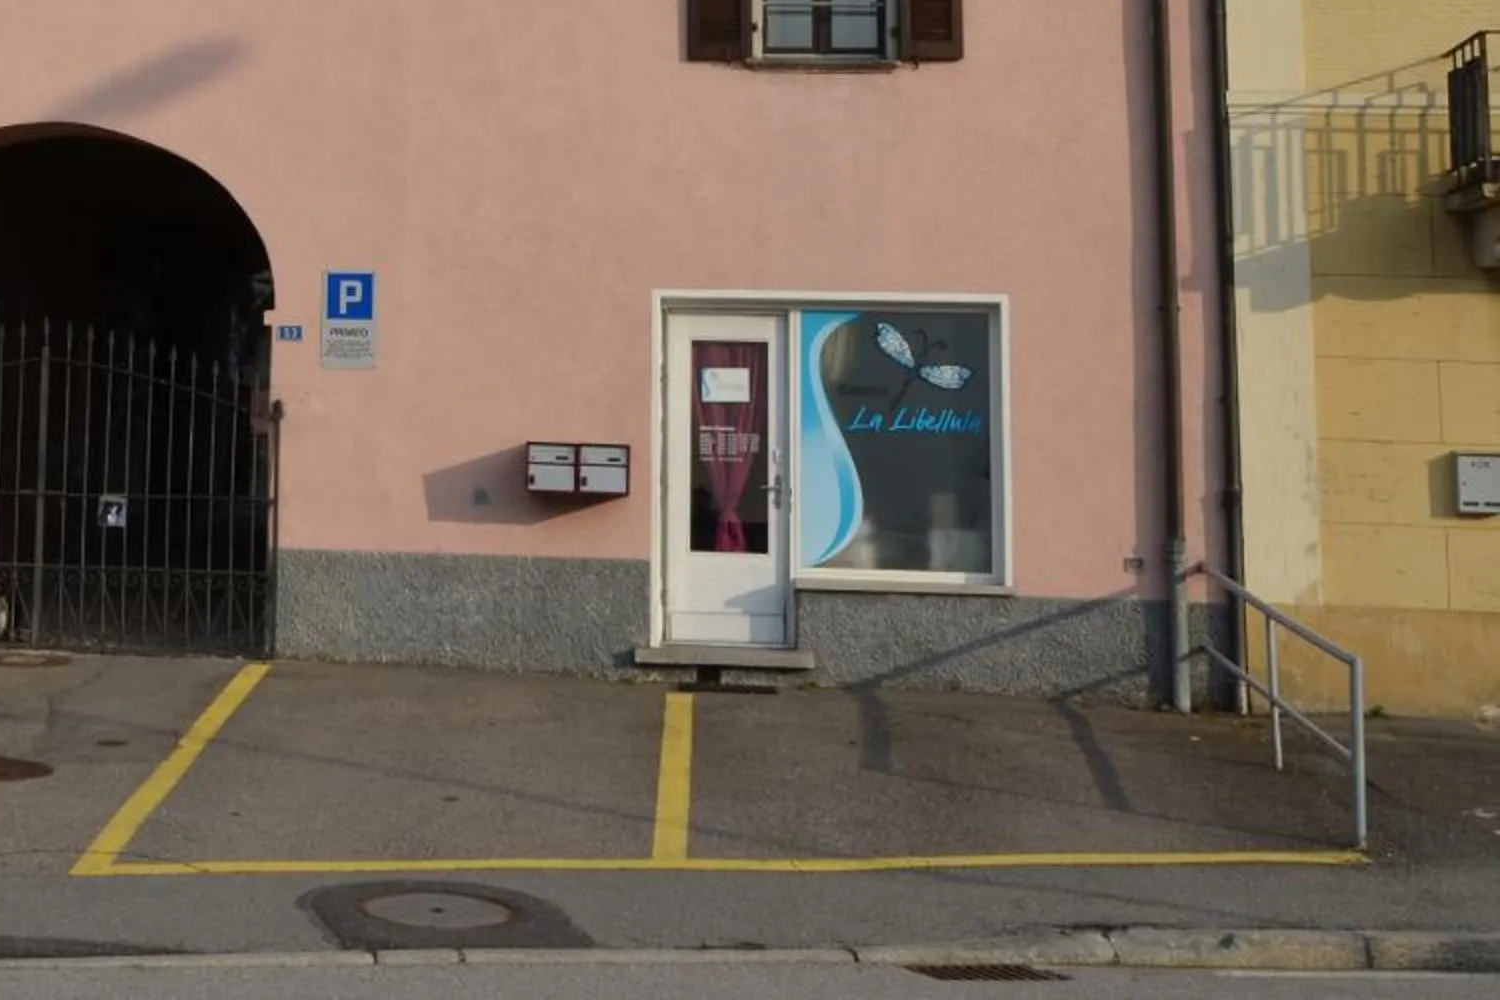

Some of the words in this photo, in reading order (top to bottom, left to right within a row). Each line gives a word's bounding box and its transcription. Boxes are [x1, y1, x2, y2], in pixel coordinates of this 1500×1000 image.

[339, 280, 363, 315] P
[846, 404, 883, 432] La
[888, 406, 983, 435] Libellula
